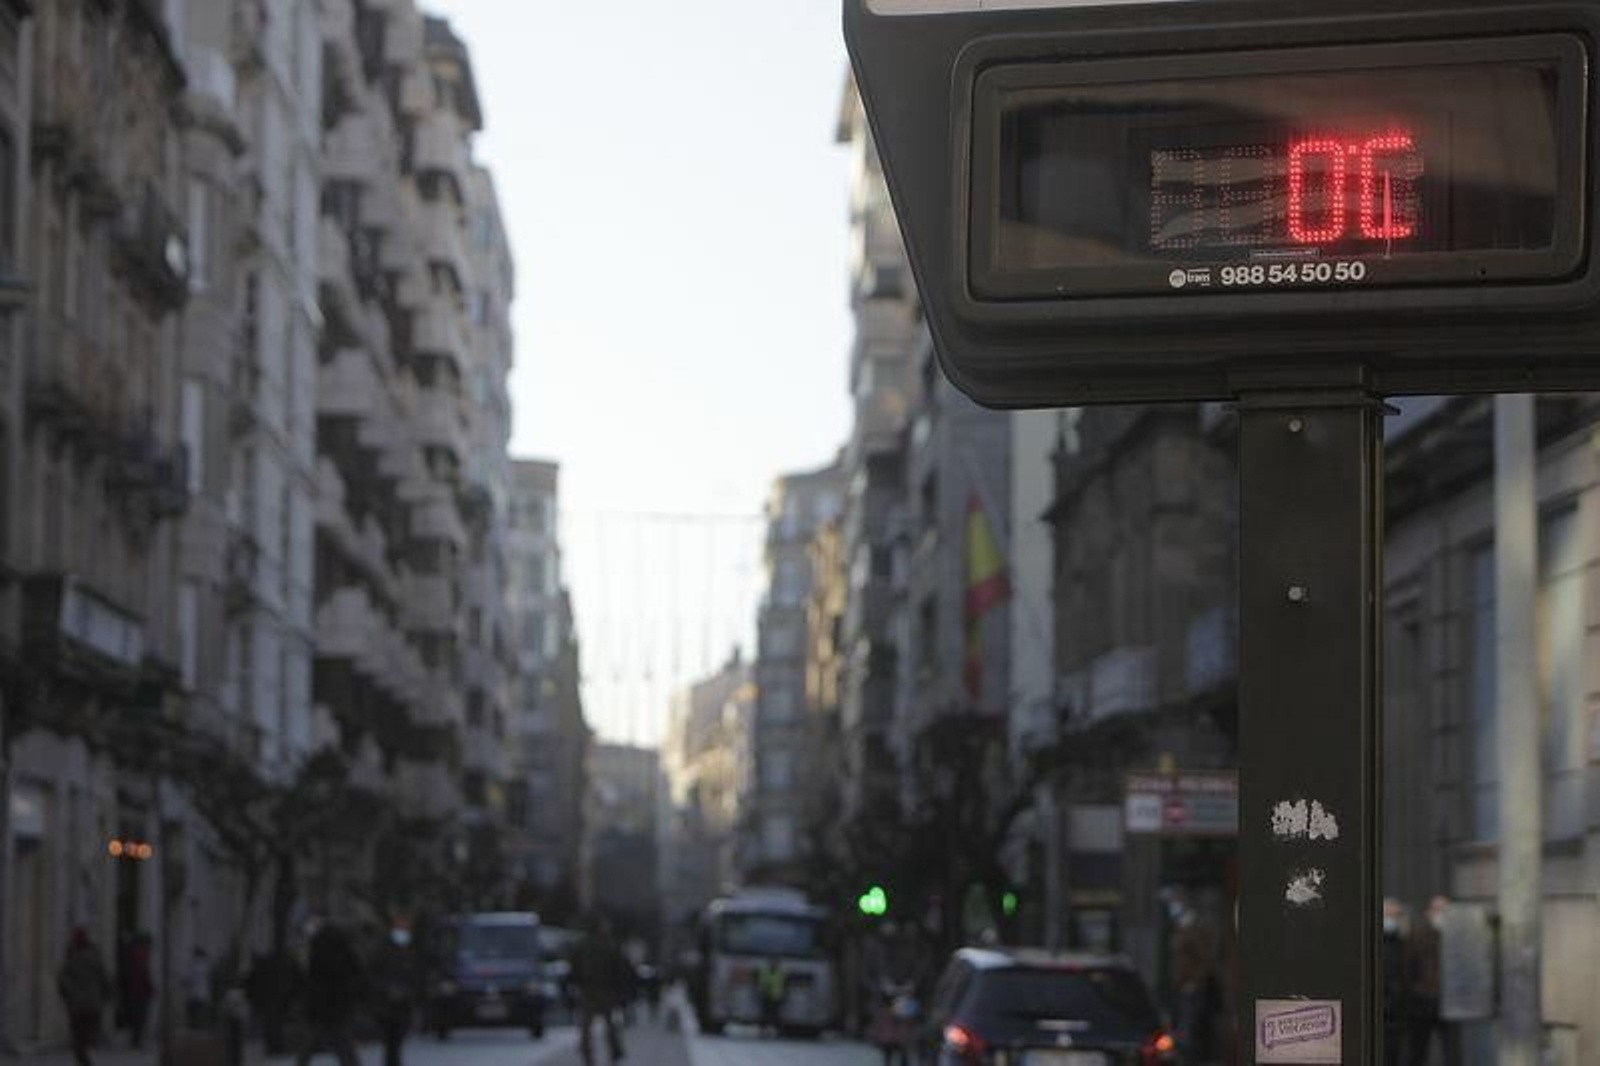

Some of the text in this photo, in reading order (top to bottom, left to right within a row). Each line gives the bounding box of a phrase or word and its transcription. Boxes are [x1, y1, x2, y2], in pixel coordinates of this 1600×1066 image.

[1221, 267, 1264, 285] 988
[1268, 265, 1297, 283] 54
[1301, 264, 1331, 281] 50
[1335, 261, 1366, 280] 50
